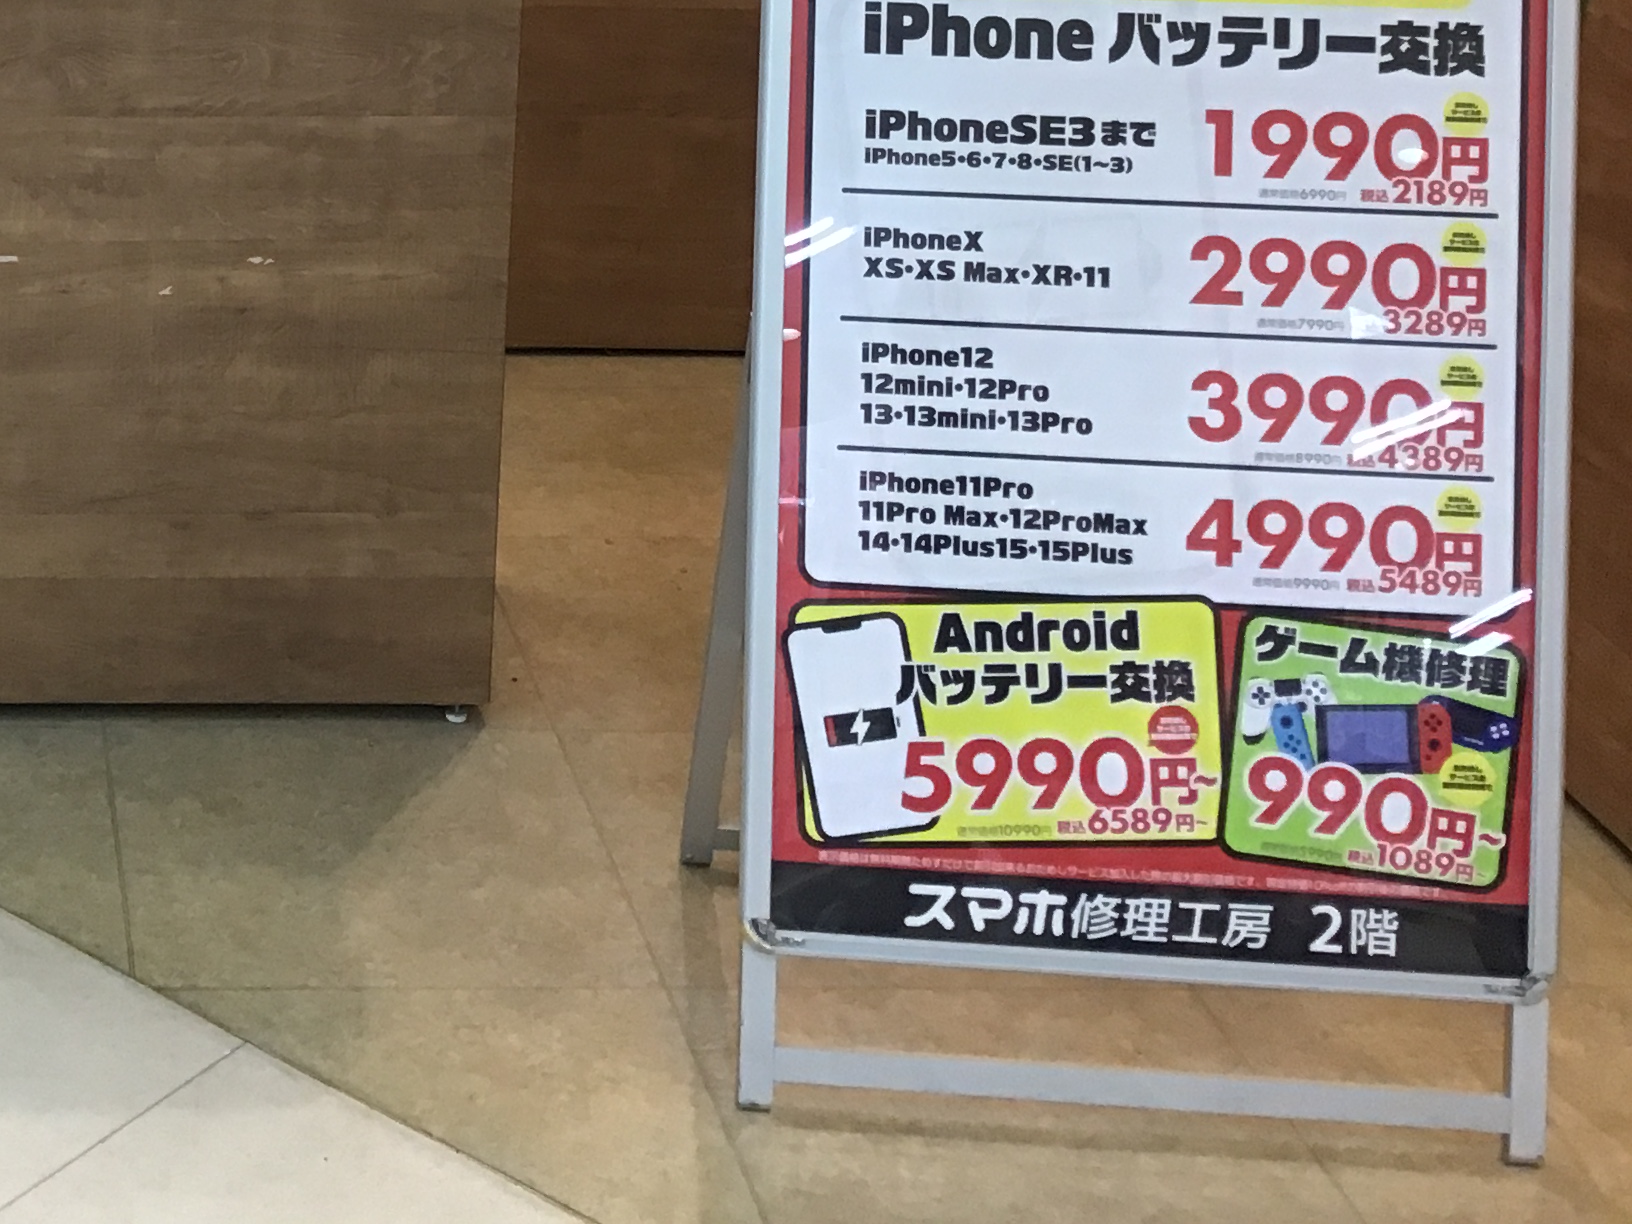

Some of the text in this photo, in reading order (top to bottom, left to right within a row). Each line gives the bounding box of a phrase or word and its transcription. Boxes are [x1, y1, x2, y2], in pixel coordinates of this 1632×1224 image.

[863, 2, 1487, 78] iPhone バッテリー交換
[863, 109, 1157, 148] iPhoneSE3まで
[1205, 107, 1490, 186] 1990円
[863, 227, 984, 253] iPhoneX
[1189, 234, 1487, 315] 2990円
[861, 341, 994, 369] iPhone12
[860, 470, 1034, 500] iPhone11Pro
[859, 500, 936, 527] 11Pro
[1185, 498, 1482, 577] 4990円
[934, 611, 1140, 656] Android
[895, 661, 1196, 708] バッテリー交換
[1254, 624, 1510, 700] ゲーム機修理
[903, 883, 1401, 959] スマホ修理工房 2階
